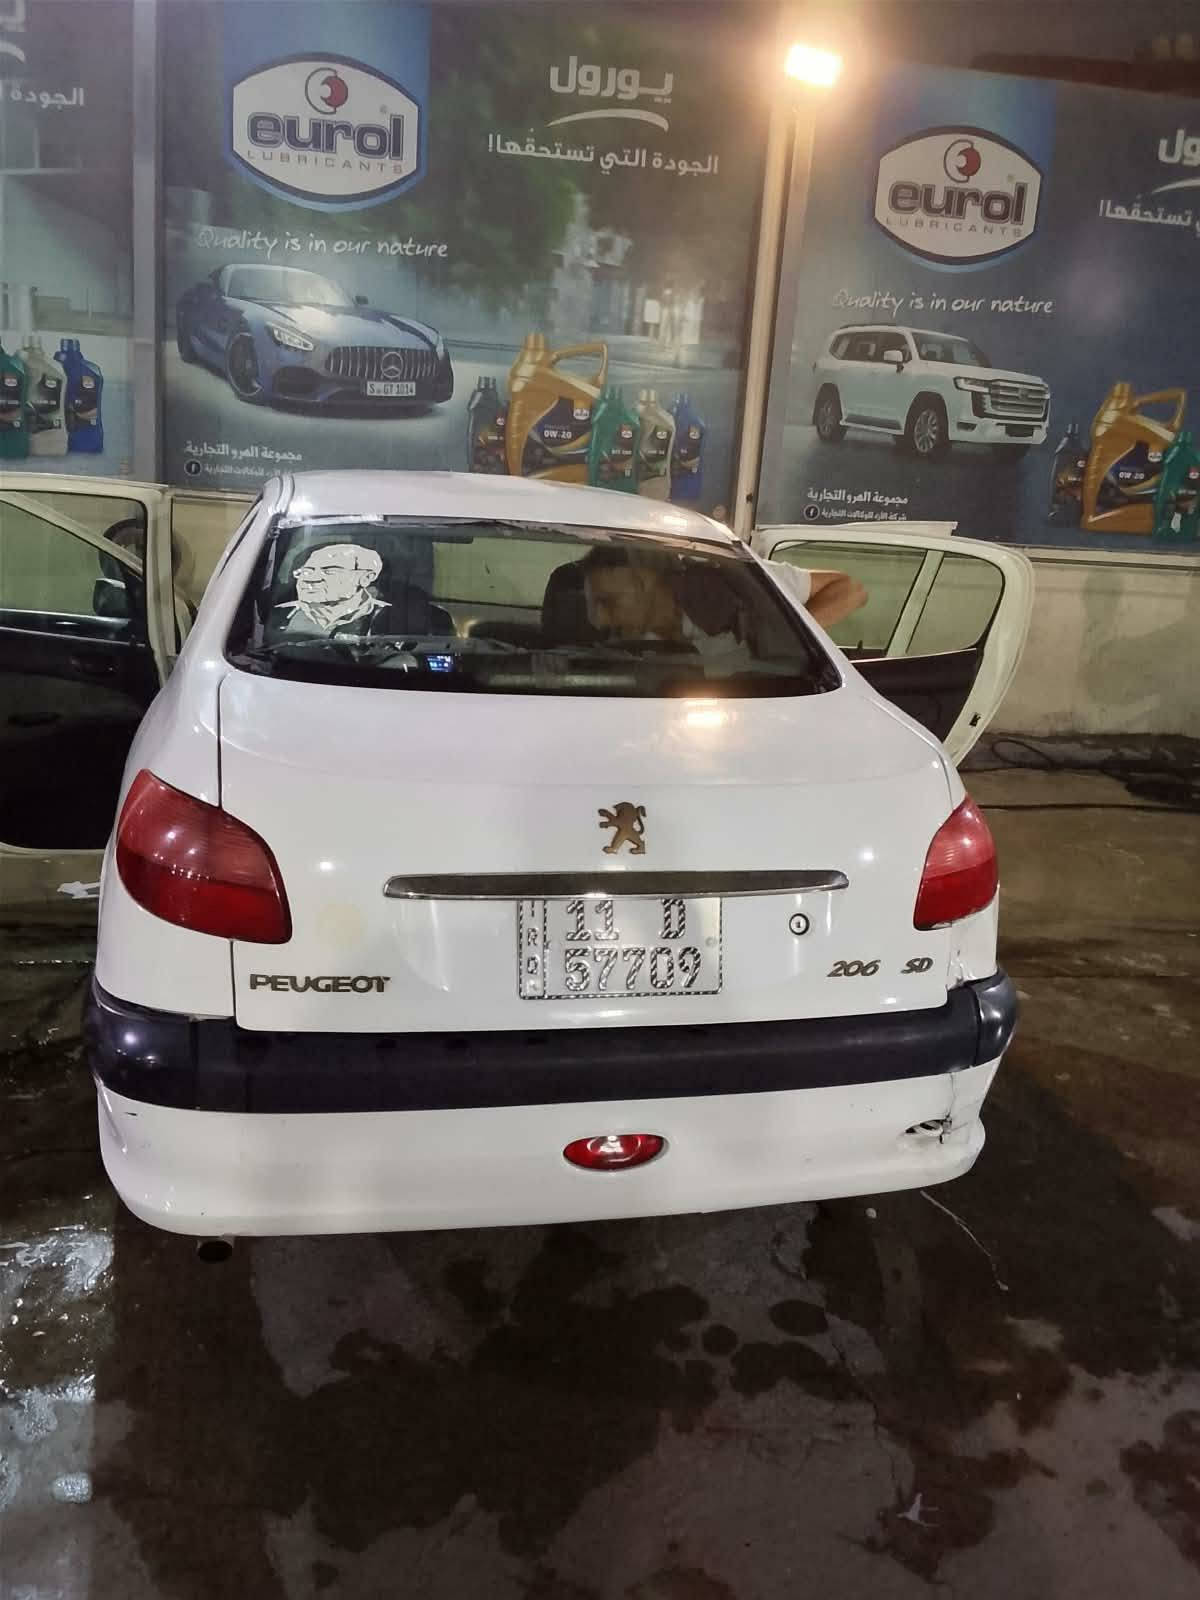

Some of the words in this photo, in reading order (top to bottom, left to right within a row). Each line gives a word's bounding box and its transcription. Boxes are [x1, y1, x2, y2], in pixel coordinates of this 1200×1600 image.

[550, 55, 674, 103] يورول
[247, 111, 404, 161] eurol
[247, 150, 403, 174] LUBRICANTS
[600, 148, 647, 174] التي
[652, 151, 719, 176] الجودة
[888, 180, 1028, 226] eurol
[886, 217, 1023, 238] LUBRICANTS
[197, 229, 277, 259] Quality
[285, 231, 302, 251] is
[308, 232, 327, 252] in
[333, 238, 371, 254] our
[377, 232, 449, 257] nature
[833, 288, 903, 317] Quality
[910, 292, 925, 310] is
[930, 292, 947, 311] in
[952, 298, 984, 312] our
[990, 292, 1053, 314] nature
[185, 440, 229, 457] التجارية
[807, 488, 846, 501] التجارية
[872, 491, 908, 507] مجموعة
[566, 899, 619, 941] 11
[565, 945, 701, 991] 57709
[826, 959, 881, 977] 206
[900, 957, 934, 974] SD
[249, 974, 391, 993] PEUGEOT
